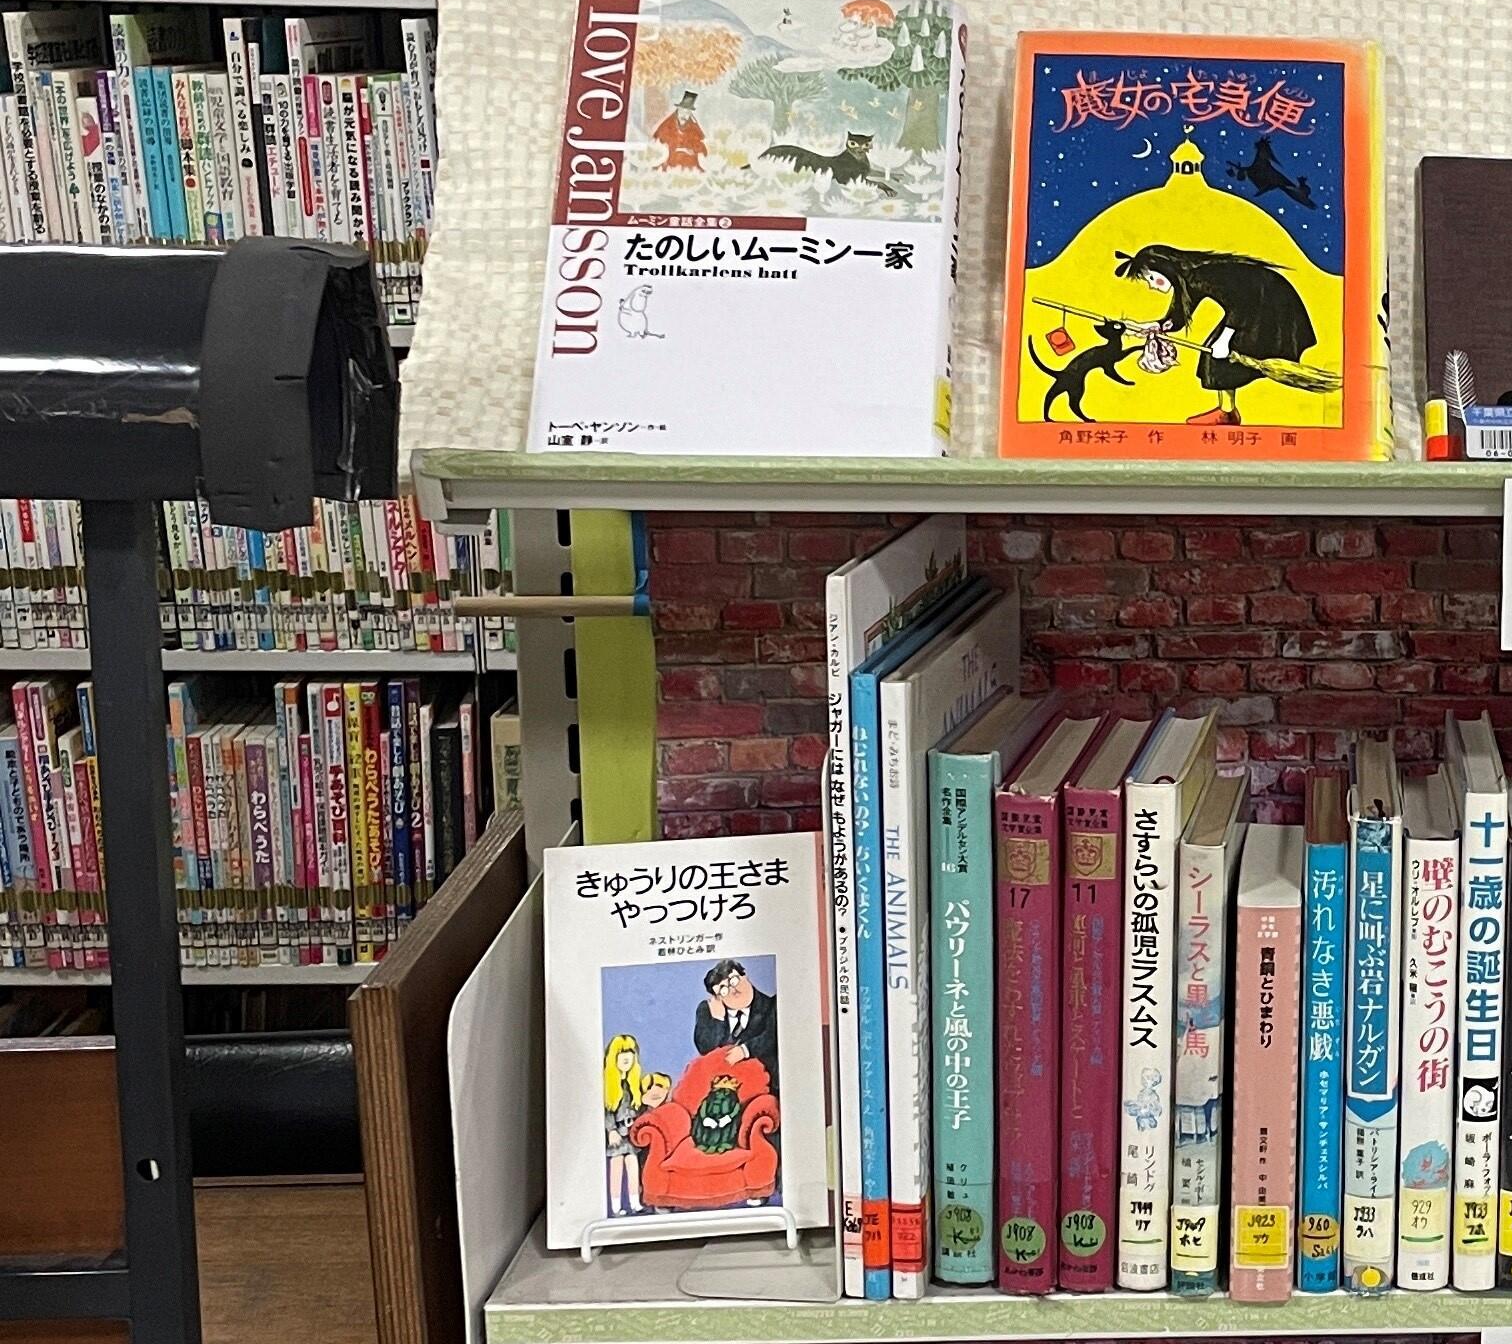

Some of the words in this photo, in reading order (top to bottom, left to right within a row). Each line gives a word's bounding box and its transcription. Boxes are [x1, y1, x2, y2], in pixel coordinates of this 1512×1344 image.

[1052, 67, 1317, 135] 魔女の宅急便
[552, 127, 649, 357] Jansson
[624, 234, 914, 270] たのしいムーミン一家
[624, 264, 752, 279] Trollkarlens
[759, 266, 798, 280] hatt
[548, 434, 574, 447] 山室
[1059, 430, 1129, 445] 角野栄子
[1148, 431, 1164, 444] 作
[1201, 431, 1218, 444] 林
[1228, 432, 1262, 446] 明子
[1281, 433, 1297, 446] 画
[829, 691, 843, 768] ジャガーには
[832, 770, 844, 805] なぜ
[250, 790, 270, 864] わらべうた
[886, 825, 900, 863] THE
[576, 857, 790, 898] きゅうりの王さま
[1010, 888, 1030, 908] 17
[1072, 883, 1097, 904] 11
[611, 892, 757, 928] やっつけろ
[1127, 808, 1162, 1048] さすらいの孤児ラスムス
[888, 870, 910, 992] ANIMALS
[1463, 811, 1506, 1062] 十一歳の誕生日
[1308, 868, 1338, 1062] 汚れなき悪戯
[1355, 869, 1388, 1087] 星に叫ぶ岩ナルガン
[1418, 856, 1455, 1093] 壁のむこうの街
[941, 900, 974, 1133] パウリーネと風の中の王子
[1308, 1218, 1330, 1231] 960
[1411, 1200, 1432, 1214] 929
